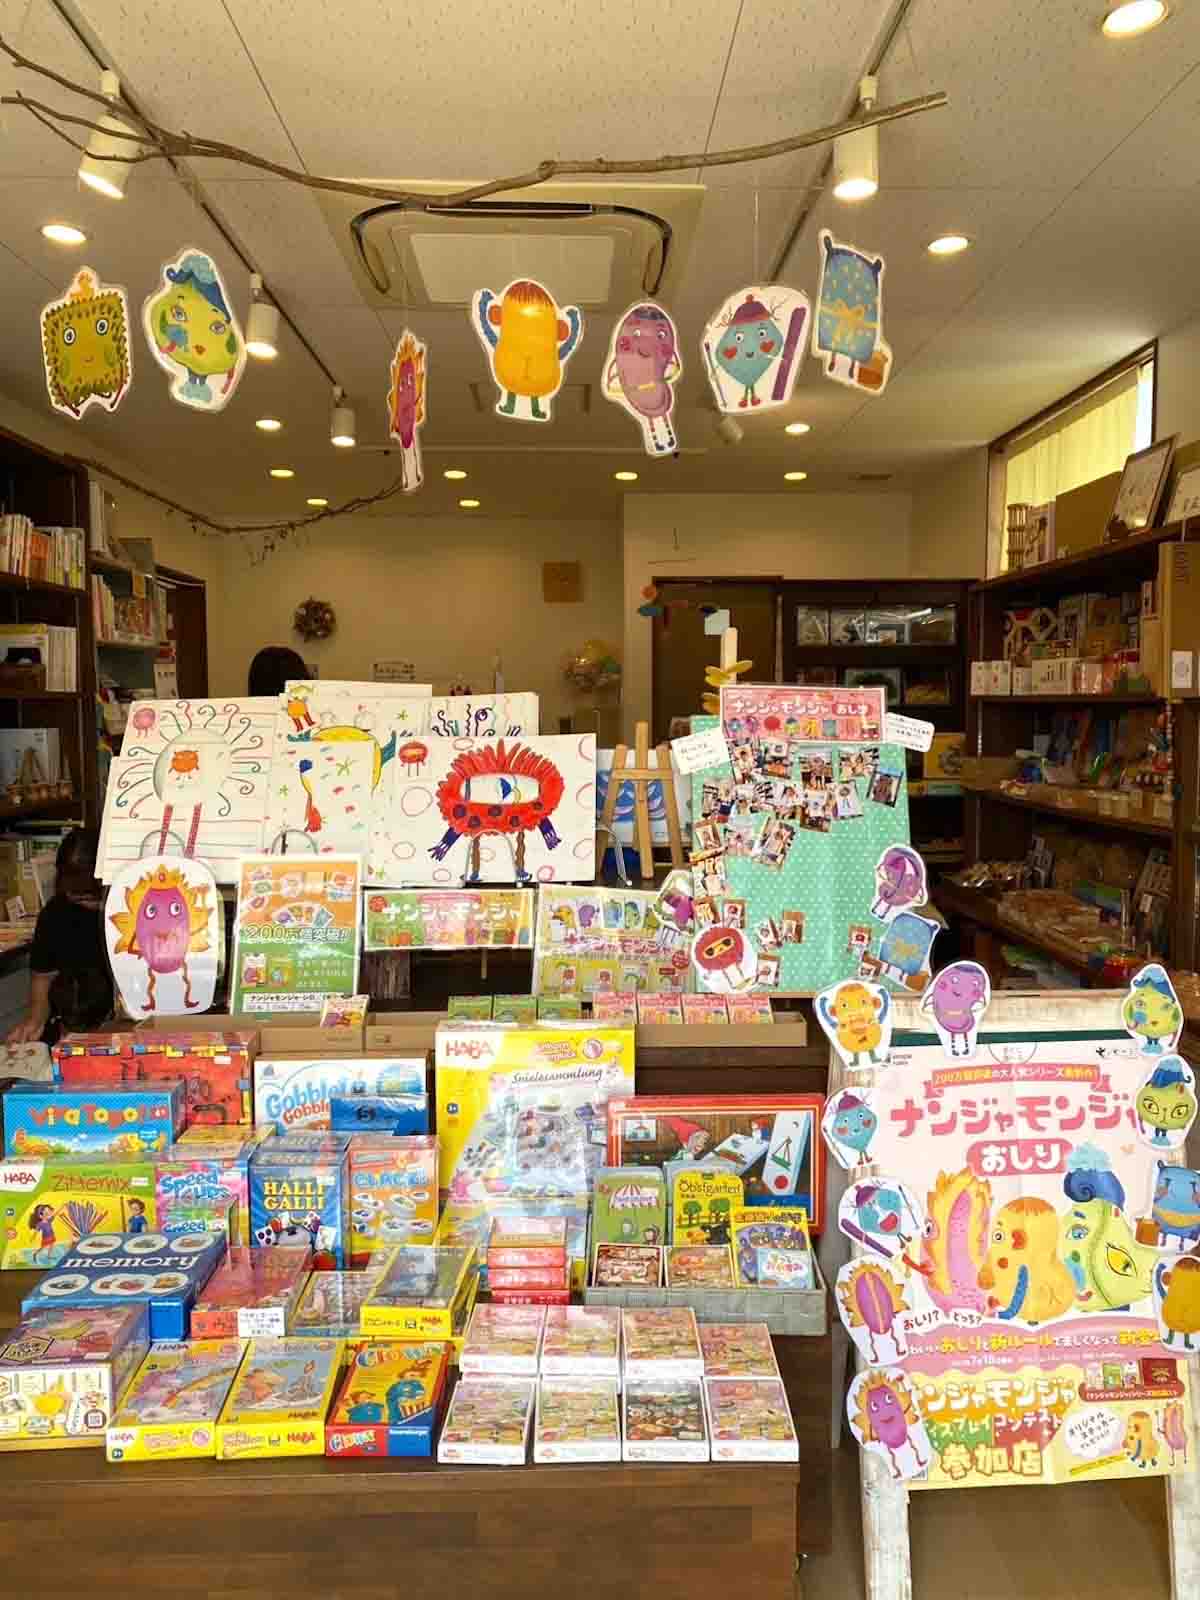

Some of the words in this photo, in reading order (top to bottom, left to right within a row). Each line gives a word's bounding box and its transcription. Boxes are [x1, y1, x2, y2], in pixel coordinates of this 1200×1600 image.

[445, 1039, 495, 1060] HABA
[511, 1065, 603, 1085] Spielesammlung
[282, 1099, 331, 1126] Gobbl
[981, 1144, 1062, 1172] おしり
[3, 1172, 37, 1185] HABA
[52, 1173, 131, 1192] Zitternix
[263, 1179, 325, 1196] HALLI
[263, 1196, 325, 1211] GALLI
[63, 1252, 200, 1272] memory
[903, 1309, 940, 1331] おしり?
[940, 1439, 1044, 1480] 参加店
